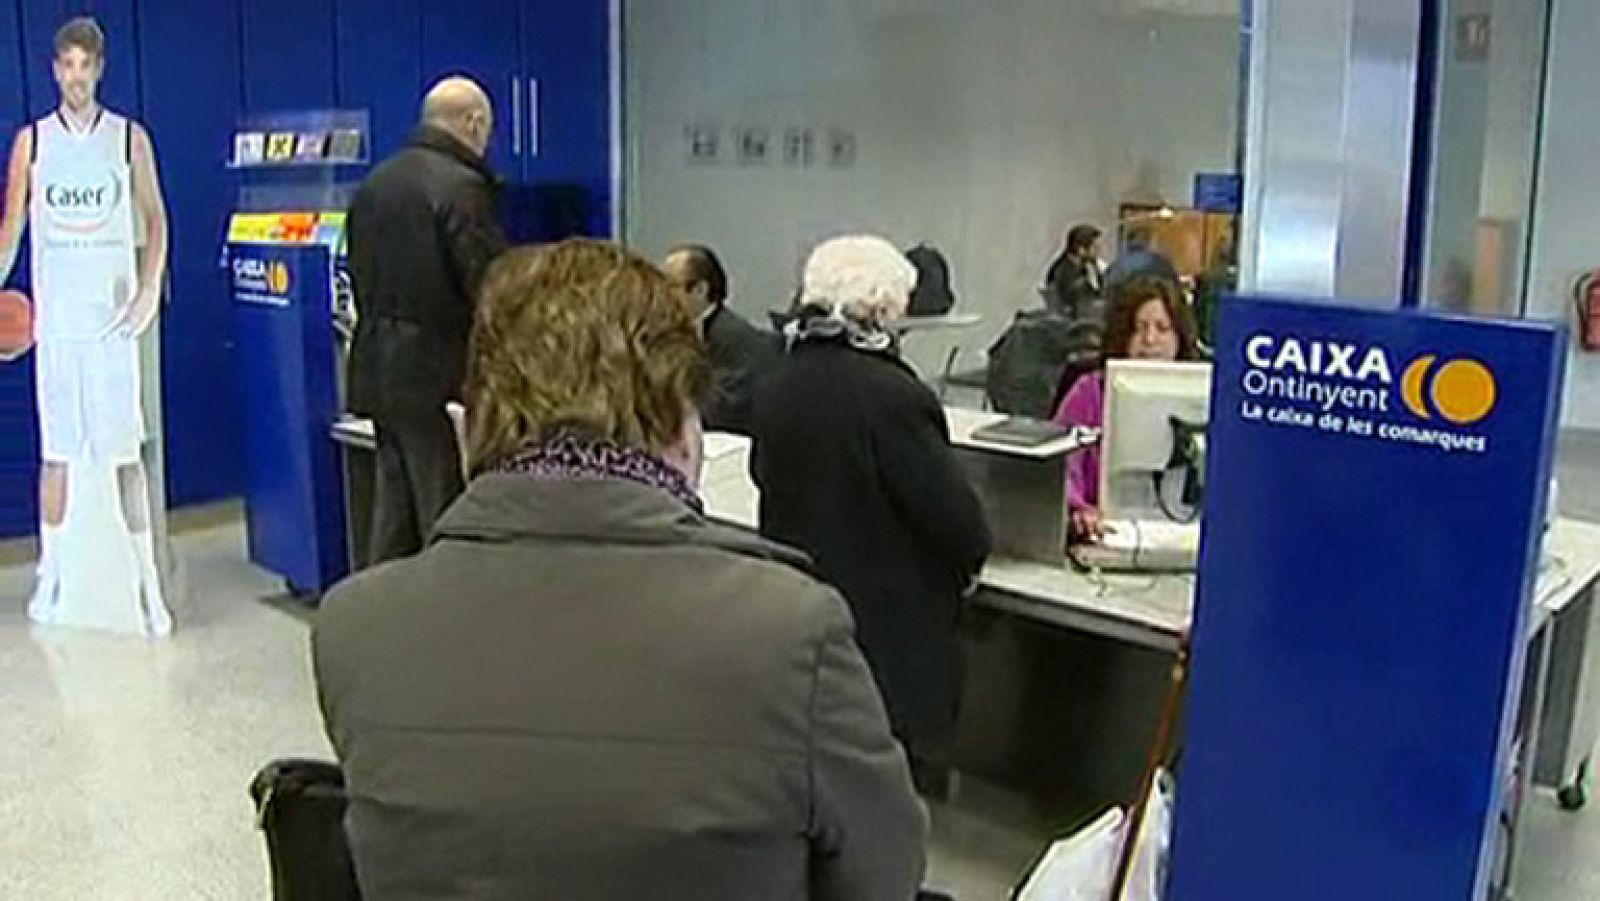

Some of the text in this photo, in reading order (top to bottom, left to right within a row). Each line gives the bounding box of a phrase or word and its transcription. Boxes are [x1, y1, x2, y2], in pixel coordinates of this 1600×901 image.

[45, 183, 105, 207] Caser
[1246, 335, 1393, 383] CAIXA
[1242, 368, 1389, 411] Ontinyent
[1241, 401, 1487, 452] La caixa de les comarques
